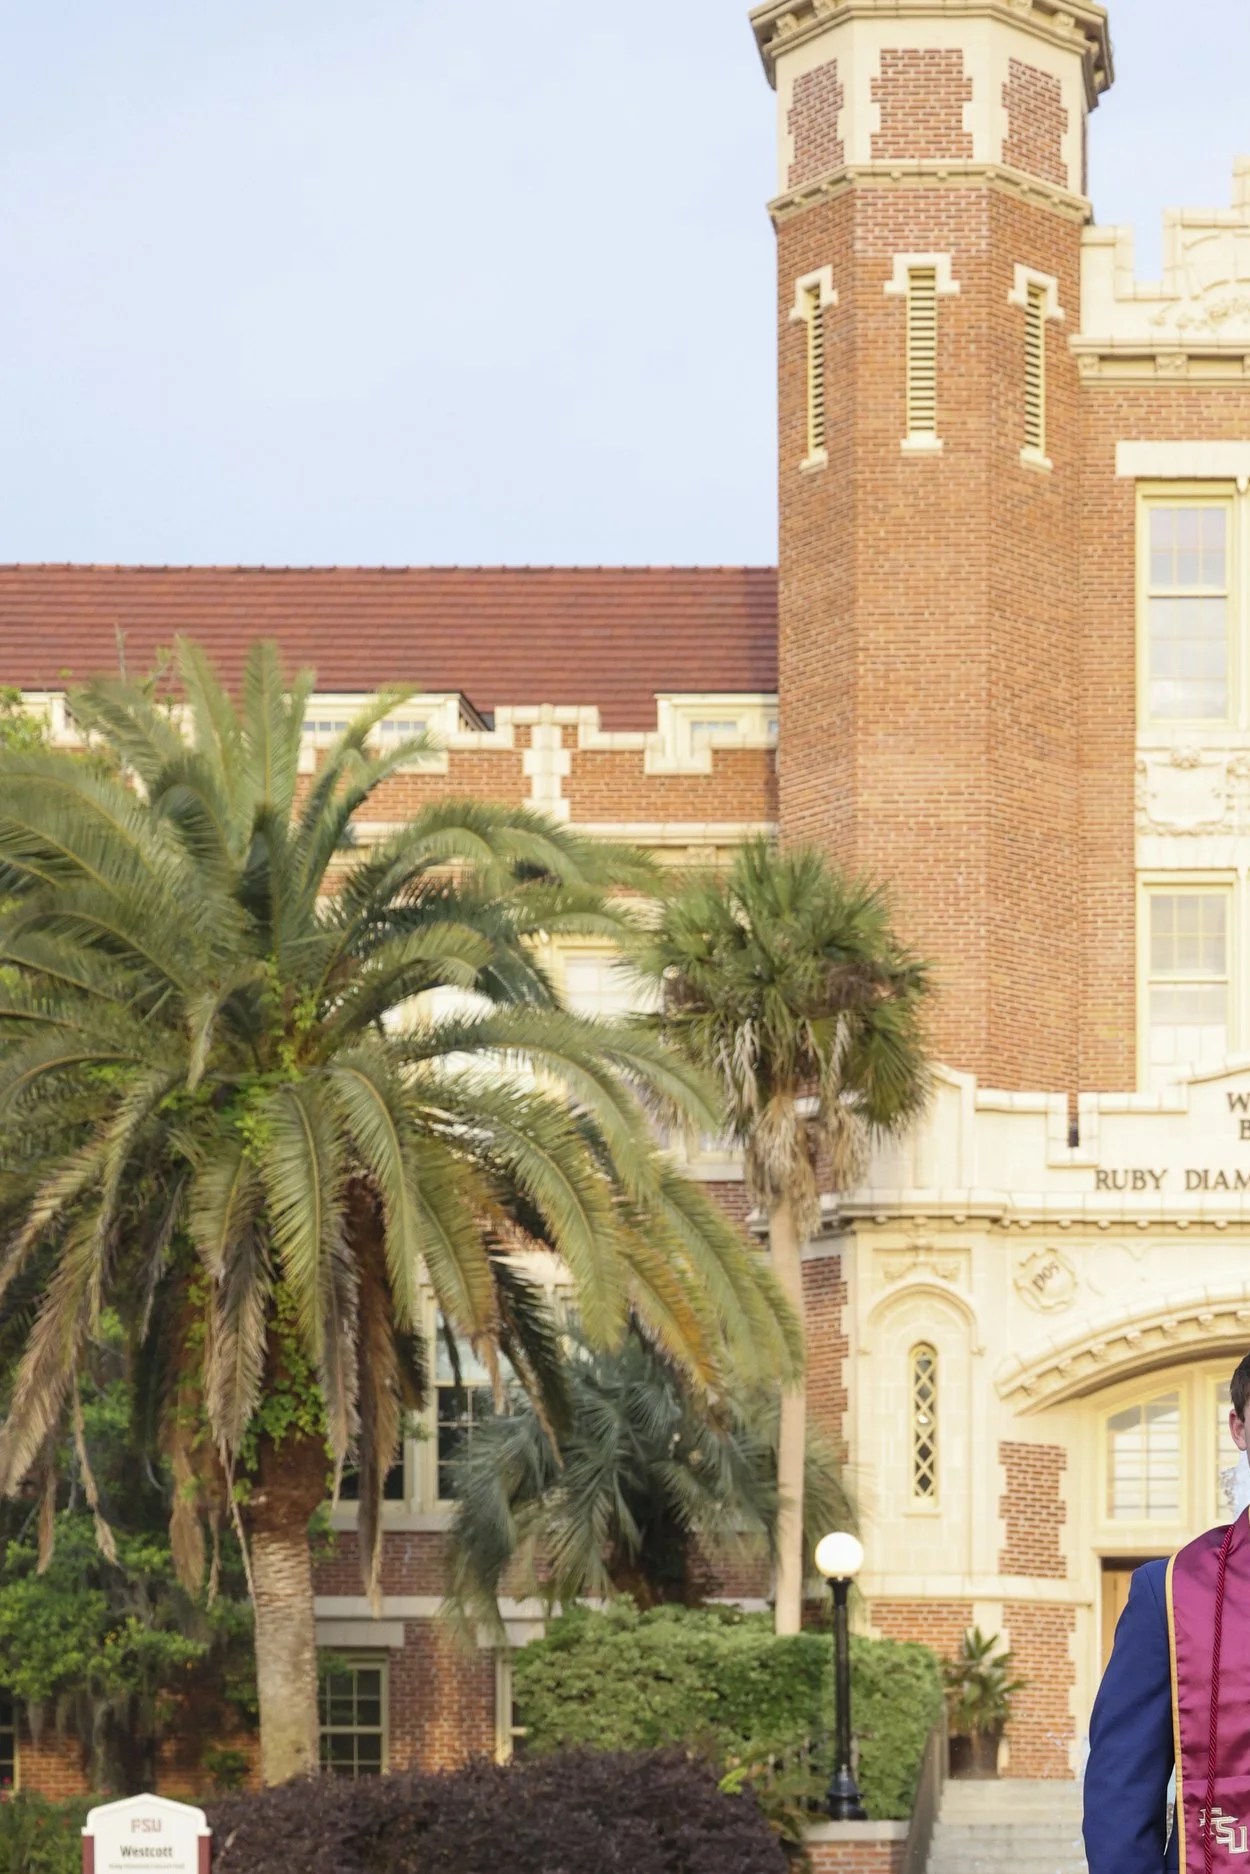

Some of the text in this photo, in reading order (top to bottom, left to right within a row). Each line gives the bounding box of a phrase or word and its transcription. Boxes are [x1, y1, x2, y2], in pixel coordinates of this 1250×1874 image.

[1094, 1168, 1168, 1191] RUBY
[131, 1818, 162, 1834] FSU
[119, 1845, 174, 1858] Westcott
